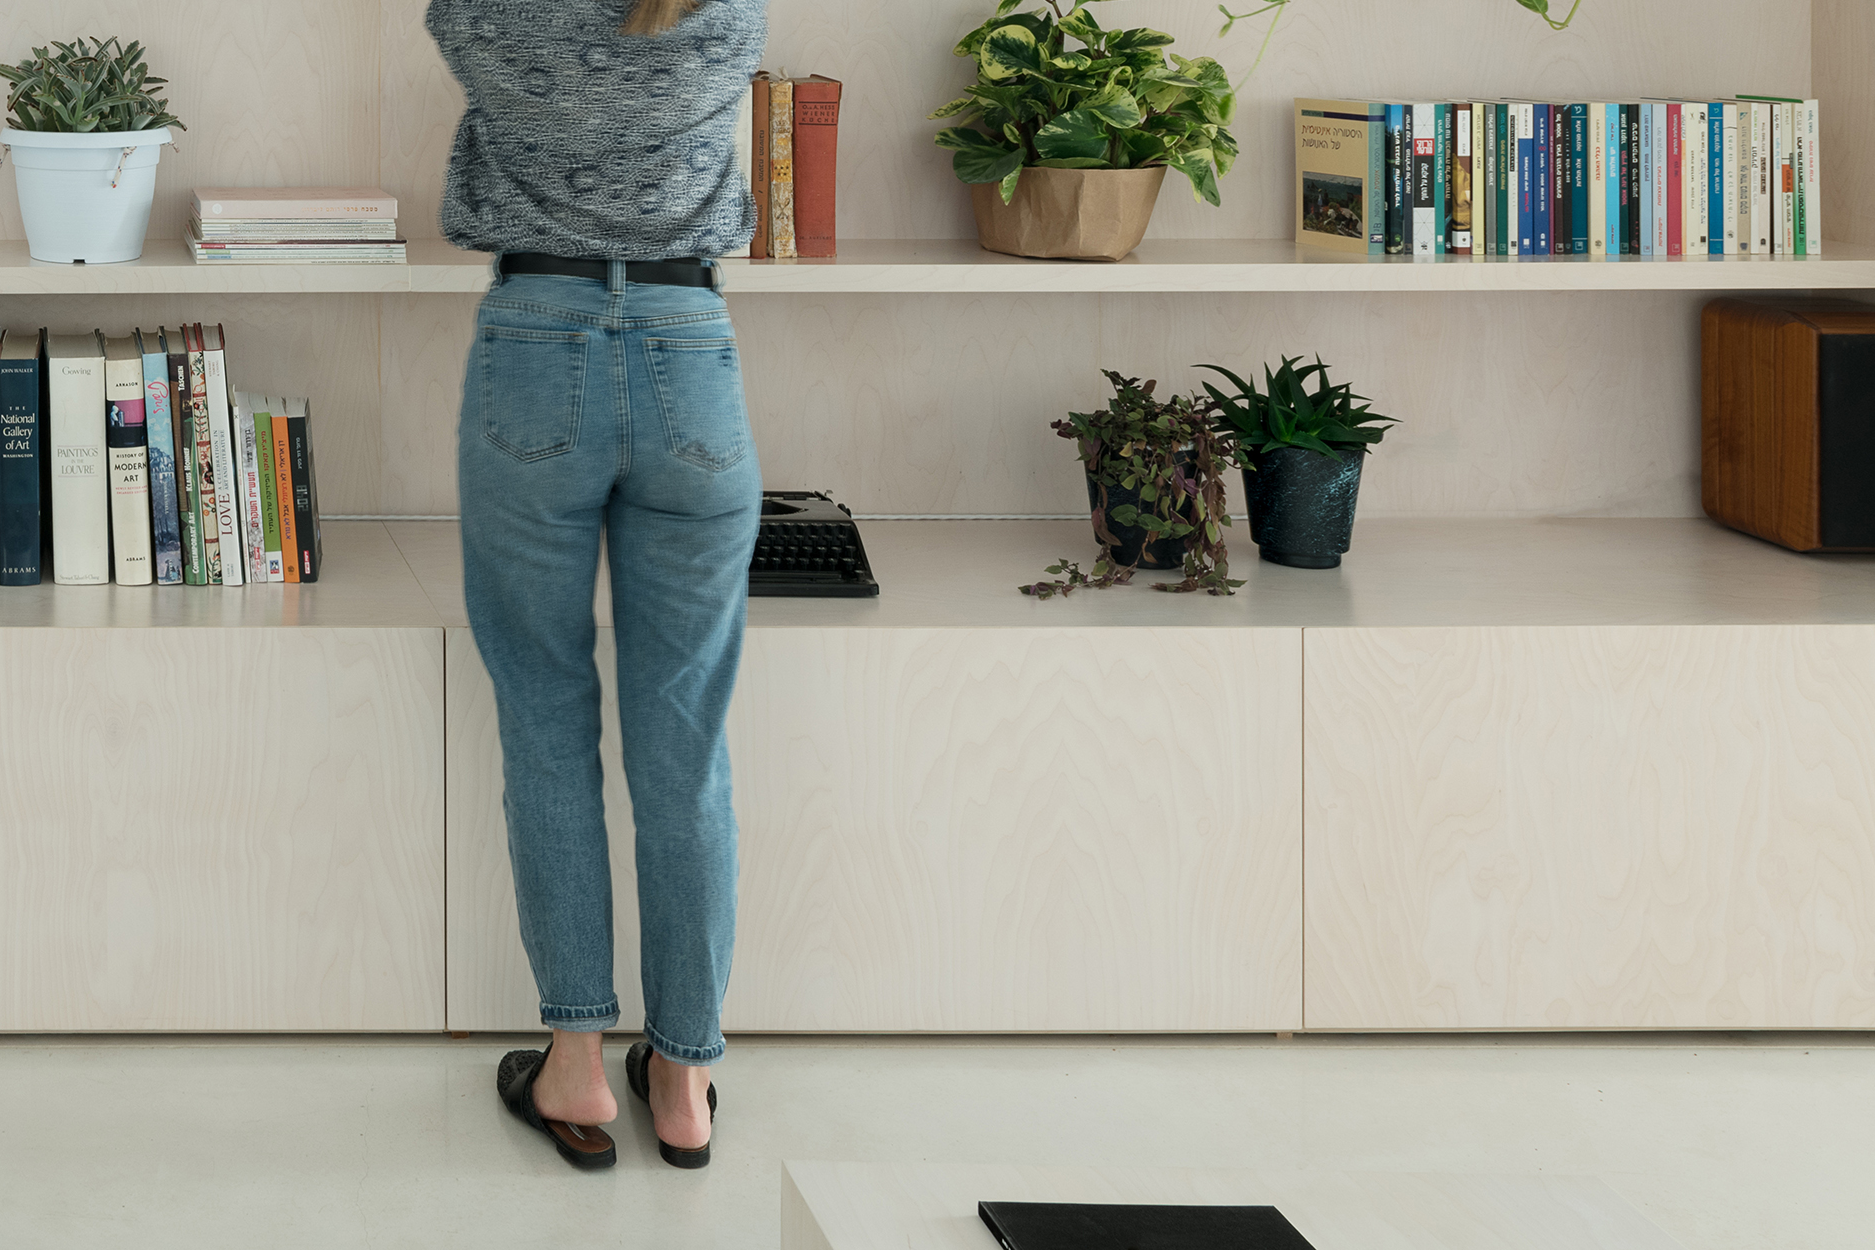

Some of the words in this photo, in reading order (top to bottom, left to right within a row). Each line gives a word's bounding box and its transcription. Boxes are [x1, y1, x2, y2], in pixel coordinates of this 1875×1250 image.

[62, 366, 92, 376] Gowing
[177, 365, 185, 392] TASCHEN
[0, 413, 35, 424] National
[2, 427, 33, 439] Gallery
[5, 440, 14, 450] of
[15, 440, 30, 450] Art
[57, 448, 98, 458] PAINTINGS
[61, 464, 94, 474] LOUVRE
[114, 462, 147, 471] MODERN
[123, 474, 139, 482] ART
[219, 493, 233, 536] LOVE
[2, 566, 37, 574] ABRAMS
